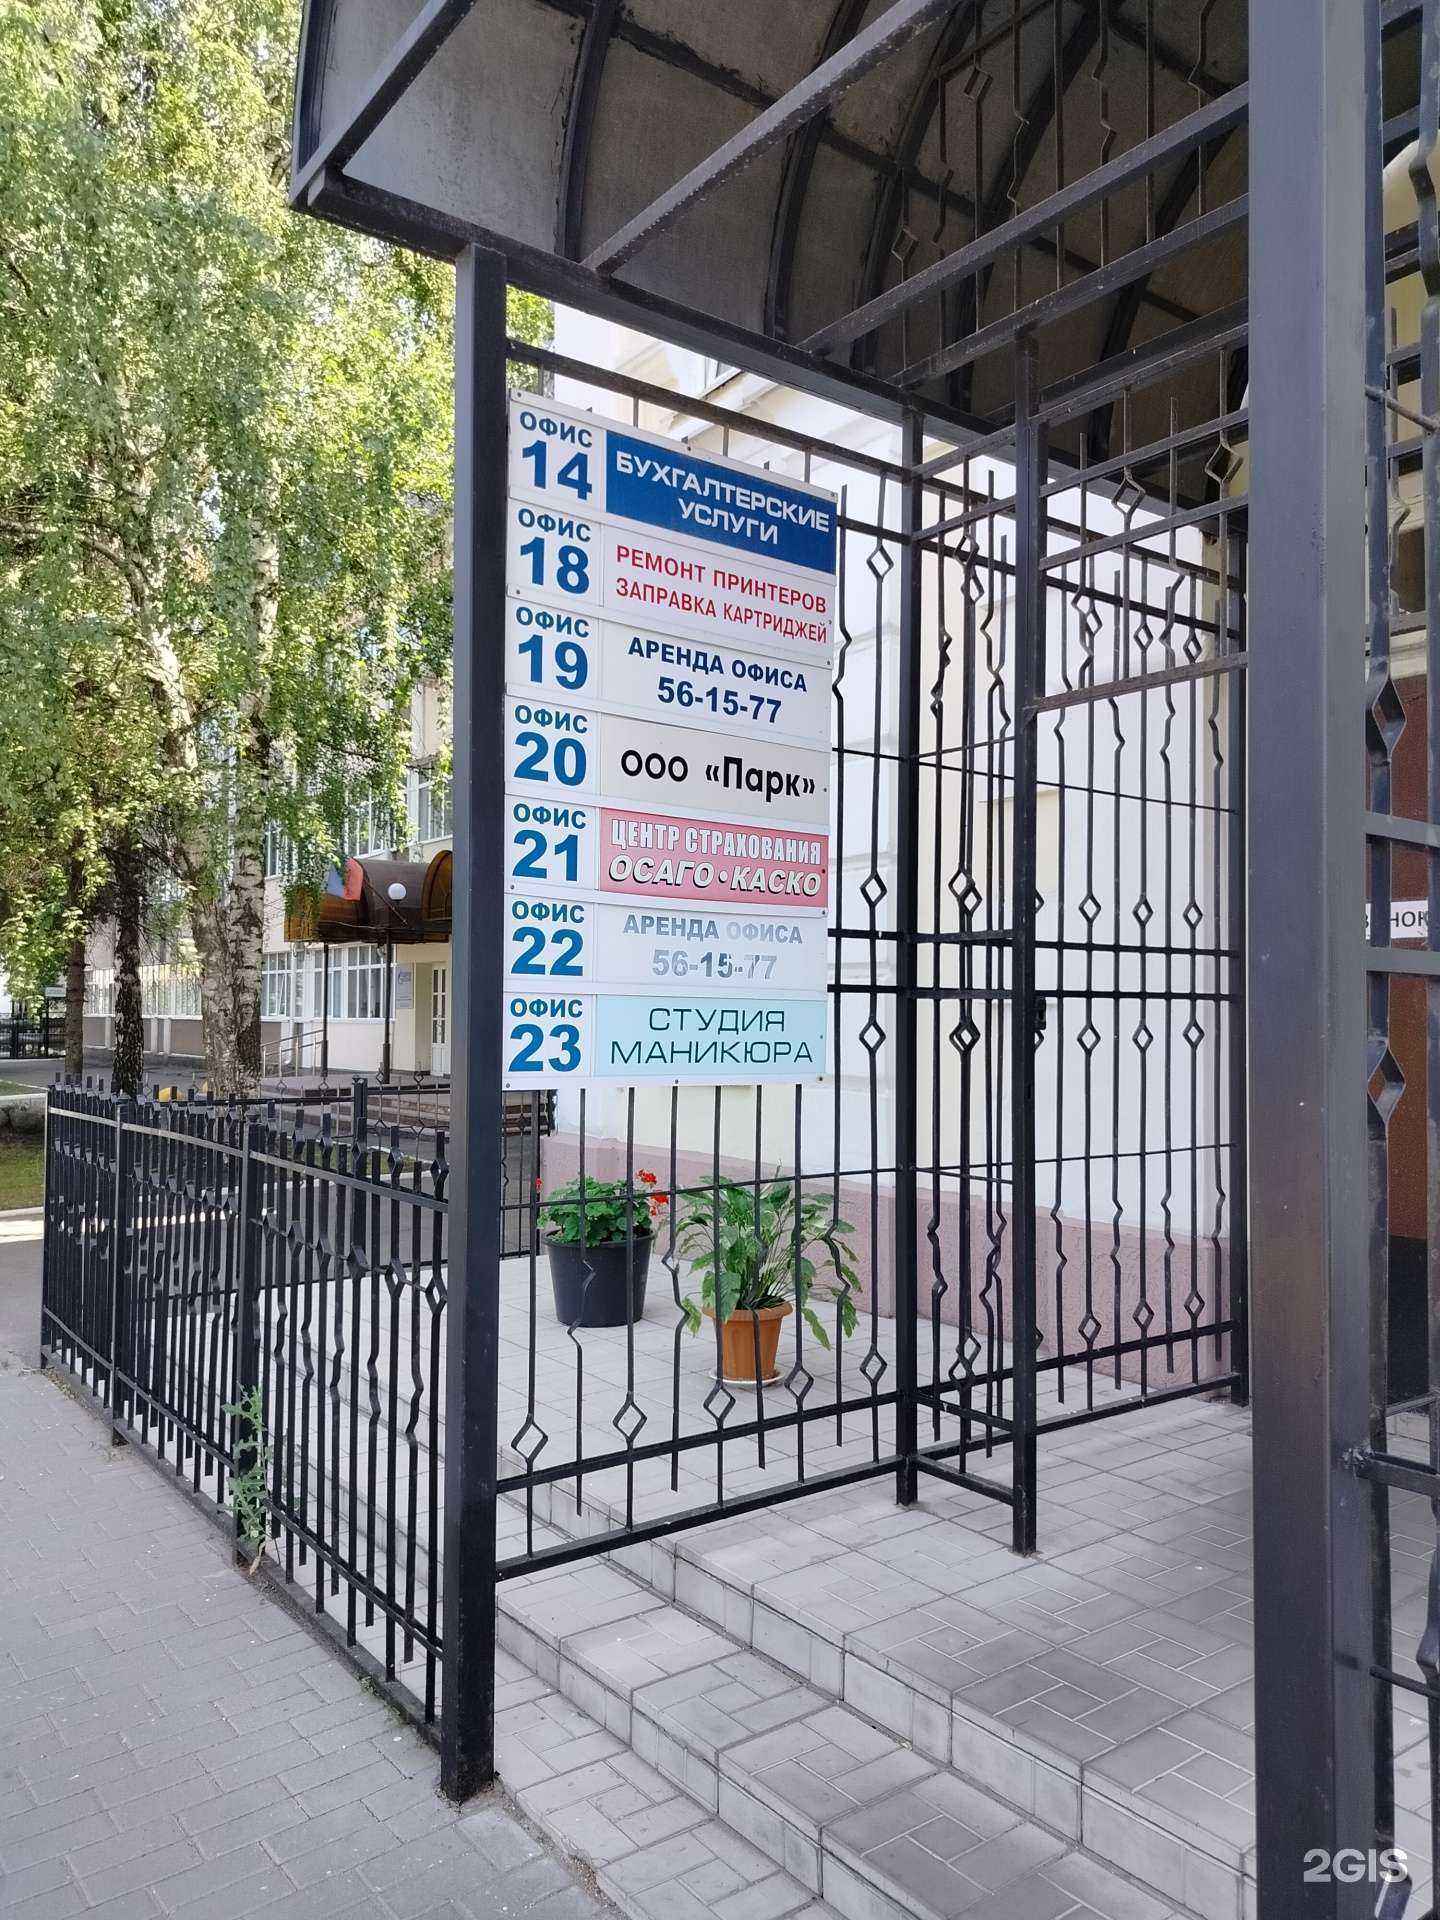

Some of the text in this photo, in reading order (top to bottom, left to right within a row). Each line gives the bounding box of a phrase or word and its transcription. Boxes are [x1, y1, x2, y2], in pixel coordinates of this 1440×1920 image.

[520, 411, 592, 448] ОФИС
[522, 440, 592, 500] 14
[616, 452, 829, 533] БУХГАЛТЕРСКИЕ
[518, 508, 591, 542] ОФИС
[678, 499, 778, 544] УСЛУГИ
[520, 537, 590, 594] 18
[617, 544, 826, 614] РЕМОНТ ПРИНТЕРОВ
[516, 607, 589, 638] ОФИС
[616, 578, 827, 643] ЗАПРАВКА КАРТРИДЖЕЙ
[518, 634, 588, 690] 19
[628, 637, 807, 692] АРЕНДА ОФИСА
[515, 704, 587, 733] ОФИС
[658, 677, 781, 723] 56-15-77
[513, 732, 587, 786] 20
[621, 749, 816, 802] ООО «Парк»
[513, 803, 586, 829] ОФИС
[512, 830, 578, 882] 21
[611, 820, 821, 865] ЦЕНТР СТРАХОВАНИЯ
[512, 901, 585, 924] ОФИС
[624, 914, 803, 944] АРЕНДА ОФИСА
[510, 927, 584, 976] 22
[652, 949, 778, 979] 56-15-77
[510, 998, 583, 1017] ОФИС
[649, 1008, 785, 1035] СТУДИЯ
[508, 1023, 581, 1072] 23
[611, 1041, 813, 1064] МАНИКЮРА
